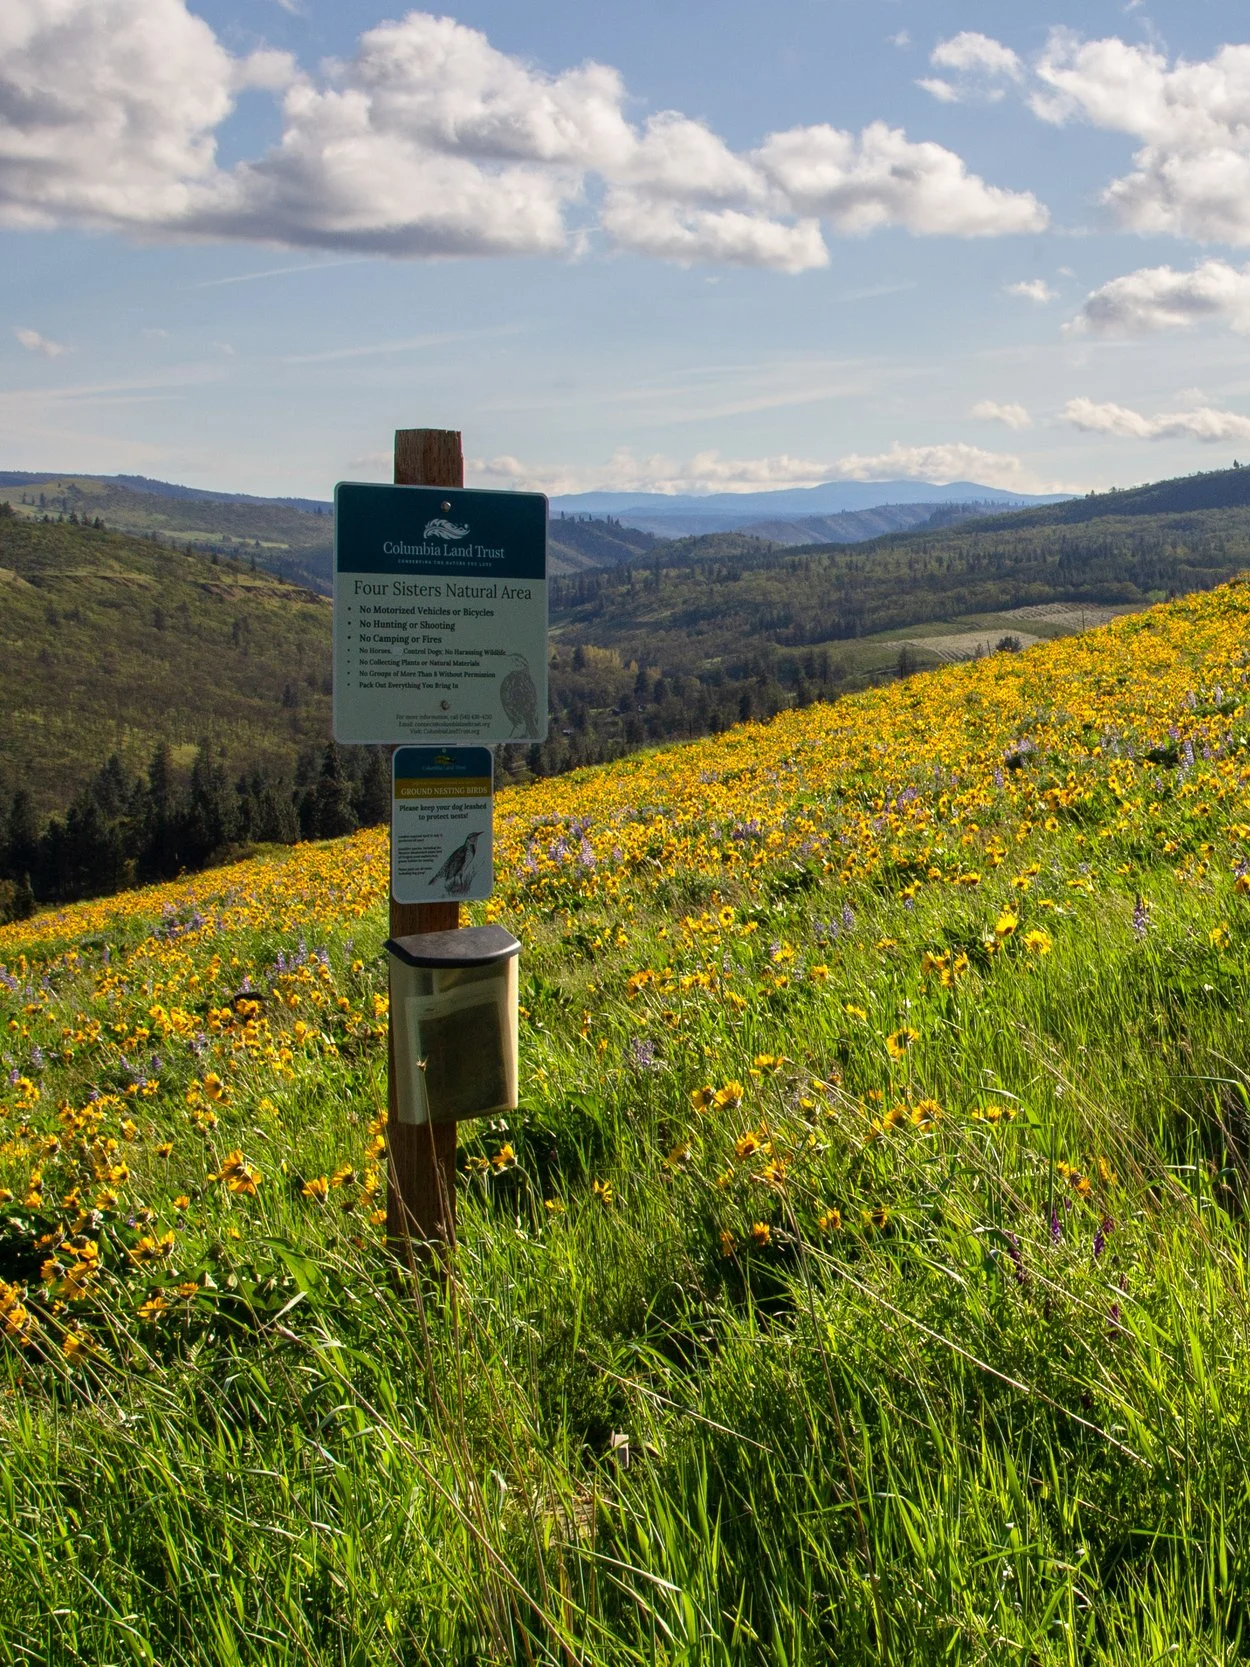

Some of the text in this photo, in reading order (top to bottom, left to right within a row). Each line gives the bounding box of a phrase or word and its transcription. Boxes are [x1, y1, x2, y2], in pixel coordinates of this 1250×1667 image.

[383, 541, 505, 559] Columbia Land Trust
[354, 580, 532, 600] Four Sisters Natural Area
[359, 605, 371, 614] No
[373, 606, 415, 615] Motorized
[417, 607, 450, 616] Vehicles
[463, 608, 494, 618] Bicycles
[359, 620, 371, 628] No
[373, 620, 407, 631] Hunting
[420, 621, 456, 632] Shooting
[359, 634, 371, 643] No
[373, 634, 409, 645] Camping
[422, 635, 442, 644] Fires
[454, 649, 483, 657] Harassing
[369, 659, 400, 667] Collecting
[369, 670, 391, 678] Groups
[388, 682, 421, 690] Everything
[435, 682, 451, 690] Bring
[401, 786, 488, 796] GROUND NESTING BIRDS
[399, 804, 419, 812] Please
[420, 804, 435, 812] keep
[451, 804, 463, 812] dog
[426, 814, 449, 822] protect
